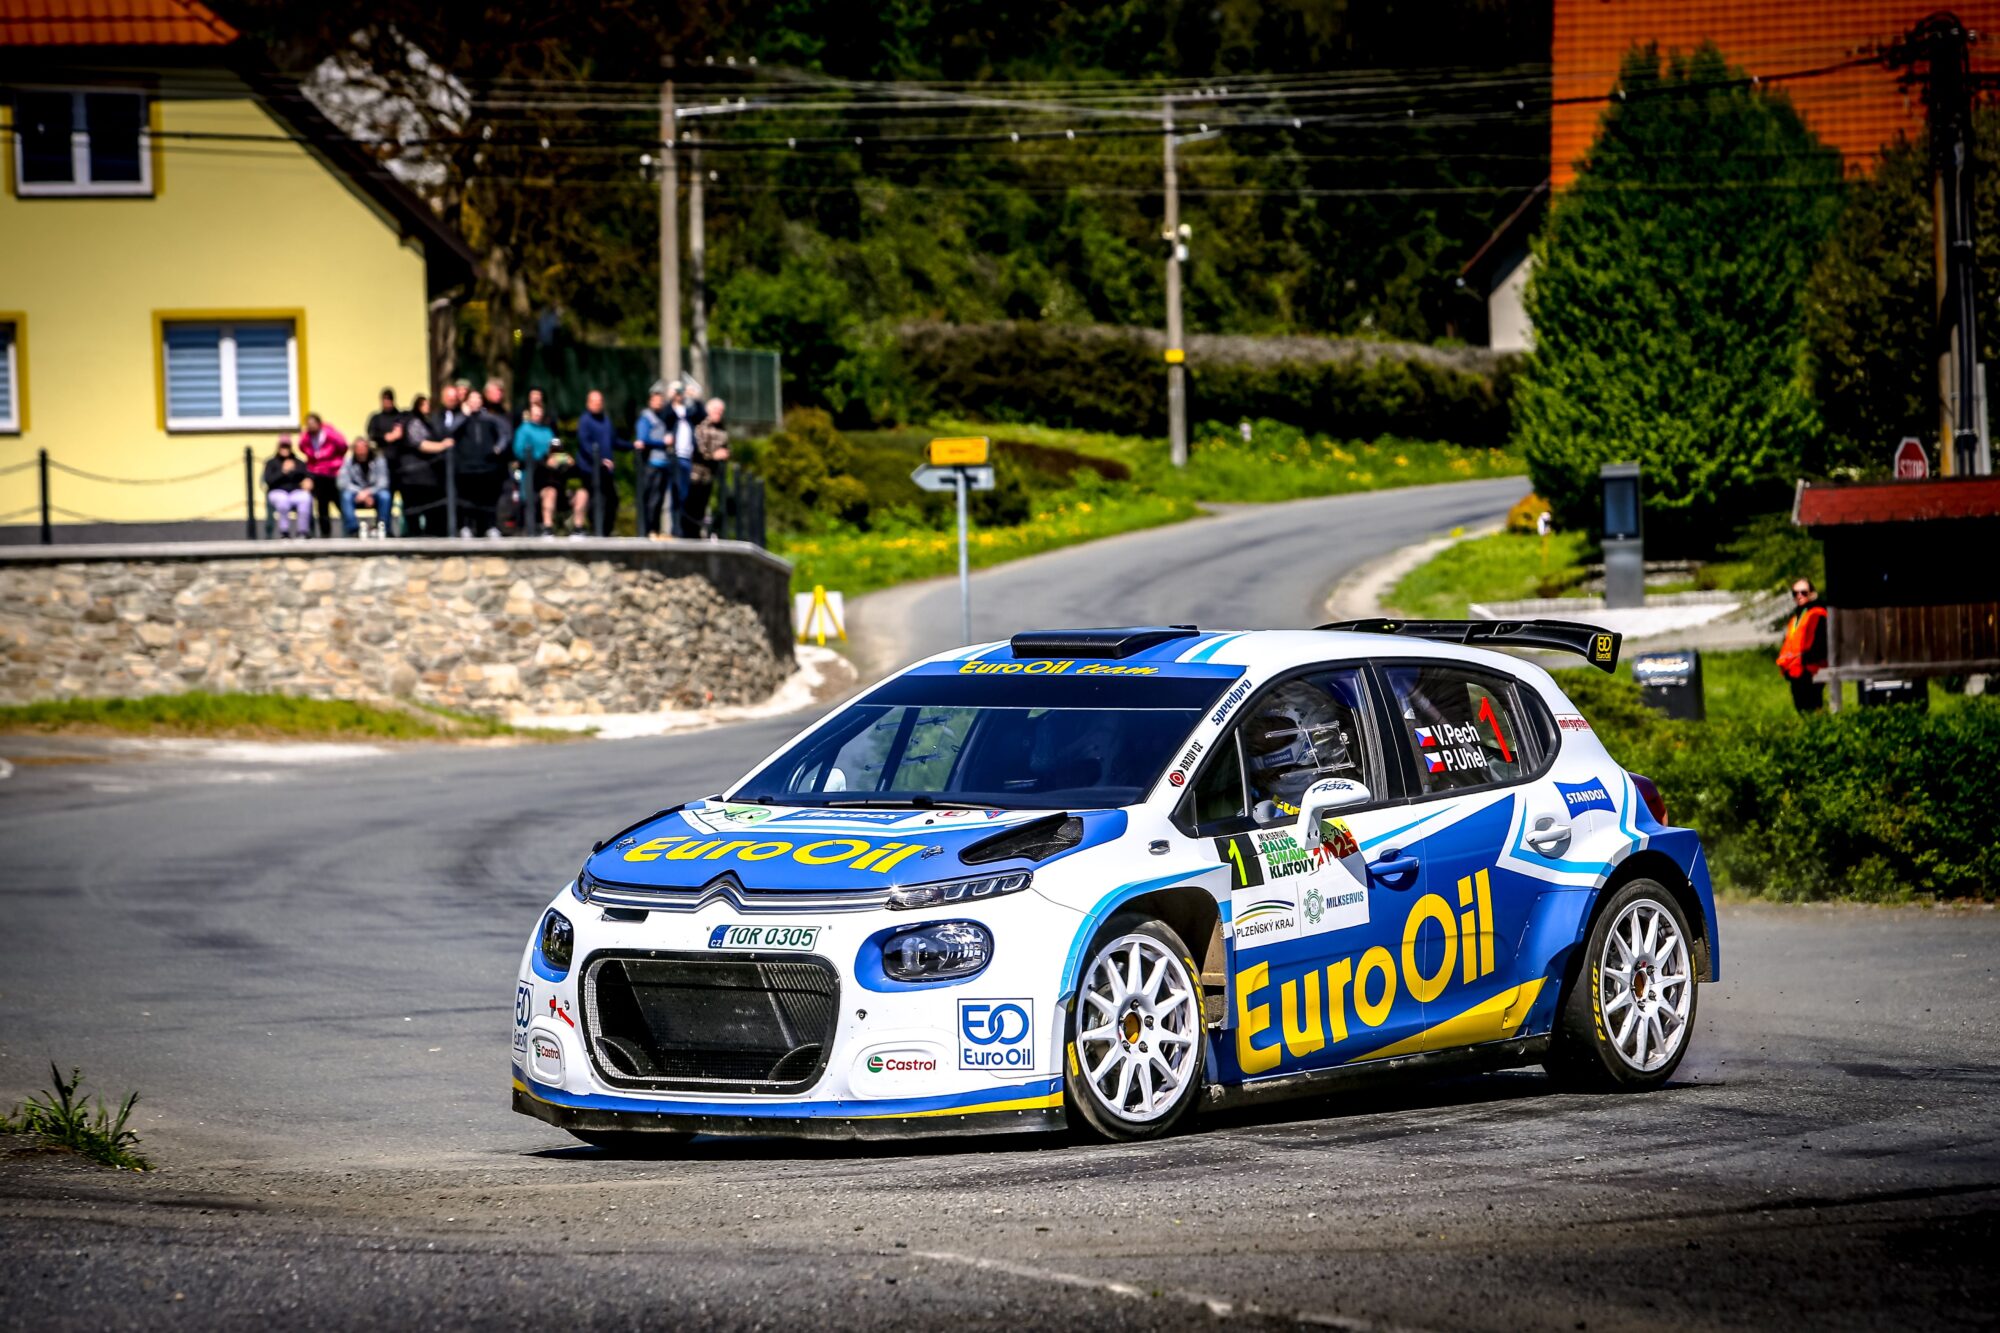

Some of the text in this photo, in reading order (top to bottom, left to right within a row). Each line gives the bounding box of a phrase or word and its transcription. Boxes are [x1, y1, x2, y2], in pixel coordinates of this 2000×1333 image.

[959, 660, 1160, 676] EuroOil team
[1211, 679, 1253, 726] speedpro
[1433, 721, 1481, 746] V.Pech
[1478, 696, 1512, 763] 1
[1179, 741, 1204, 772] BRZDY CZ
[1444, 747, 1488, 772] P.Uhel
[1566, 787, 1608, 805] STANDOX
[624, 835, 927, 874] EuroOil
[1228, 838, 1248, 886] 1
[1269, 857, 1315, 880] KLATOVY
[1326, 890, 1364, 909] MILKSERVIS
[765, 928, 816, 947] 0305
[1236, 917, 1295, 938] PLZEŇSKÝ KRAJ
[1236, 867, 1495, 1075] EuroOil
[962, 1003, 1030, 1046] EO
[886, 1059, 937, 1071] Castrol
